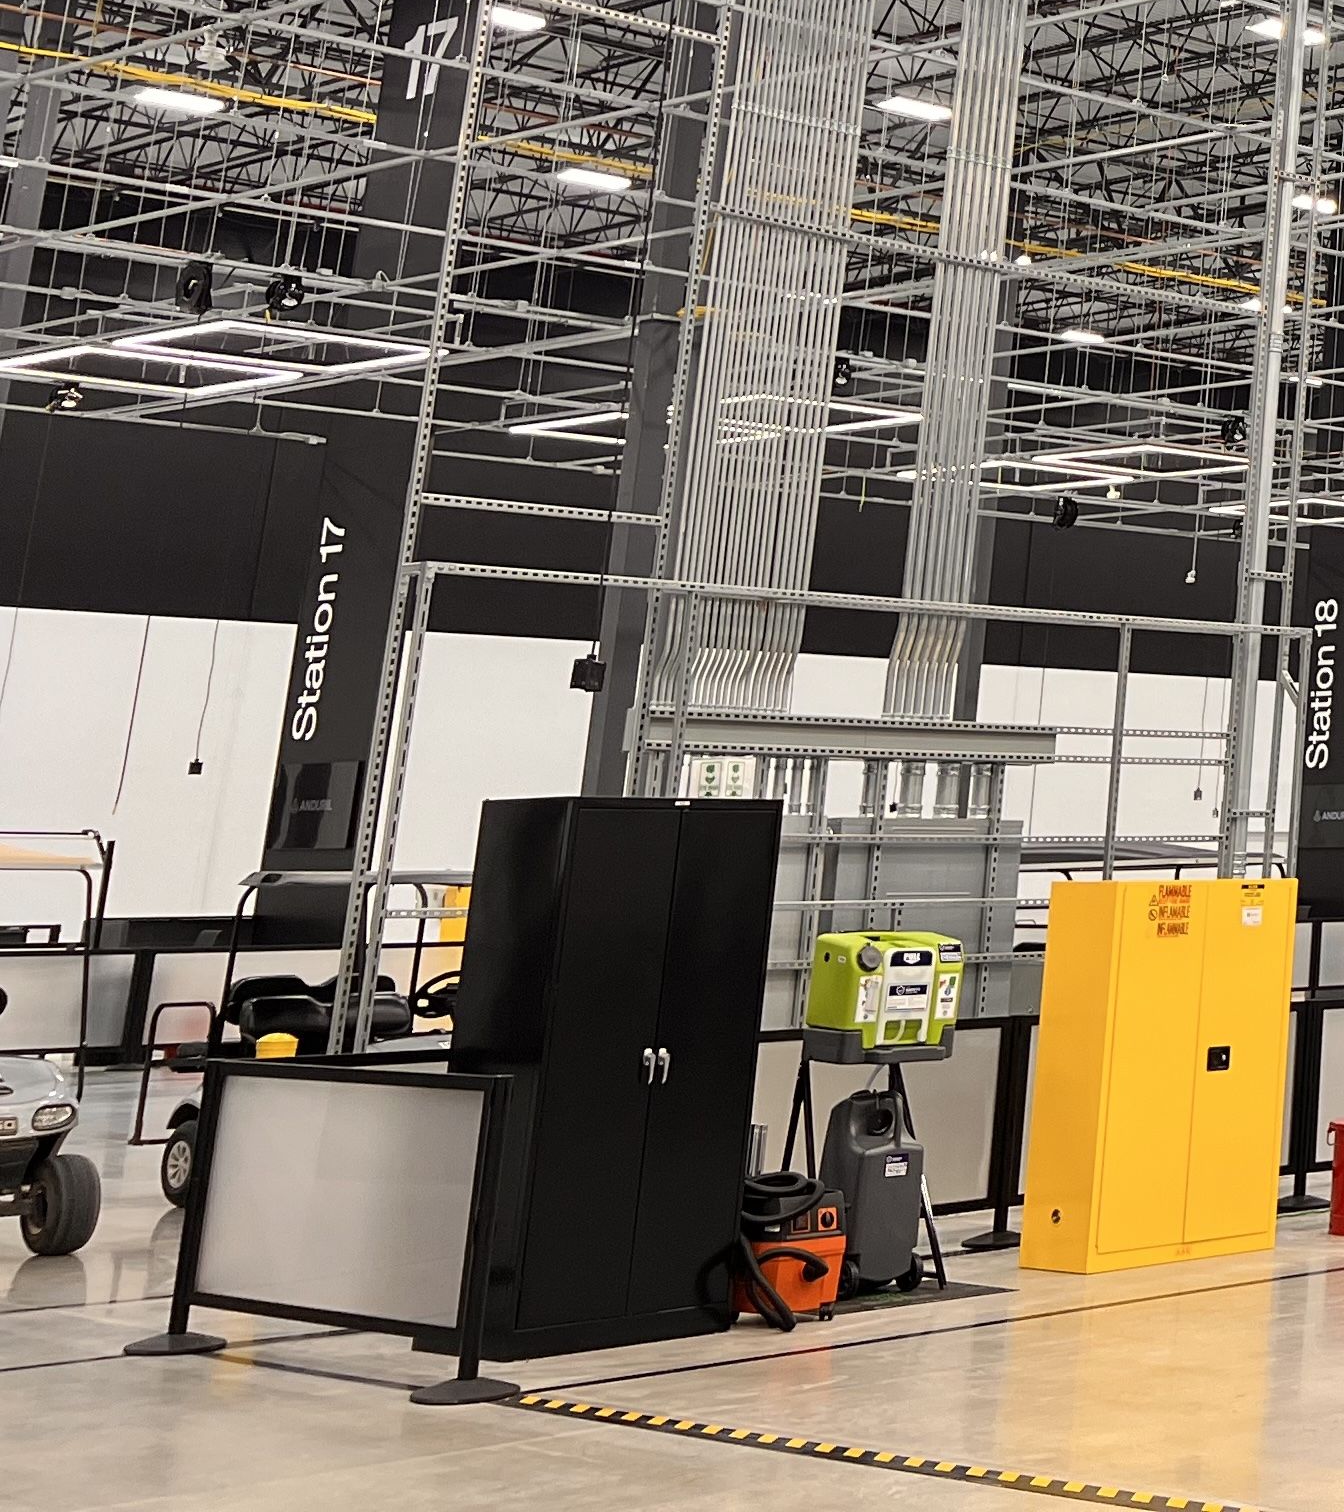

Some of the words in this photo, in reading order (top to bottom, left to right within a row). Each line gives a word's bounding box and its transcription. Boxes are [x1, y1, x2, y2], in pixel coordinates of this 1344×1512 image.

[405, 16, 458, 100] 17
[292, 574, 338, 740] Station
[320, 517, 346, 563] 17
[1315, 598, 1339, 637] 18
[1306, 645, 1336, 769] Station
